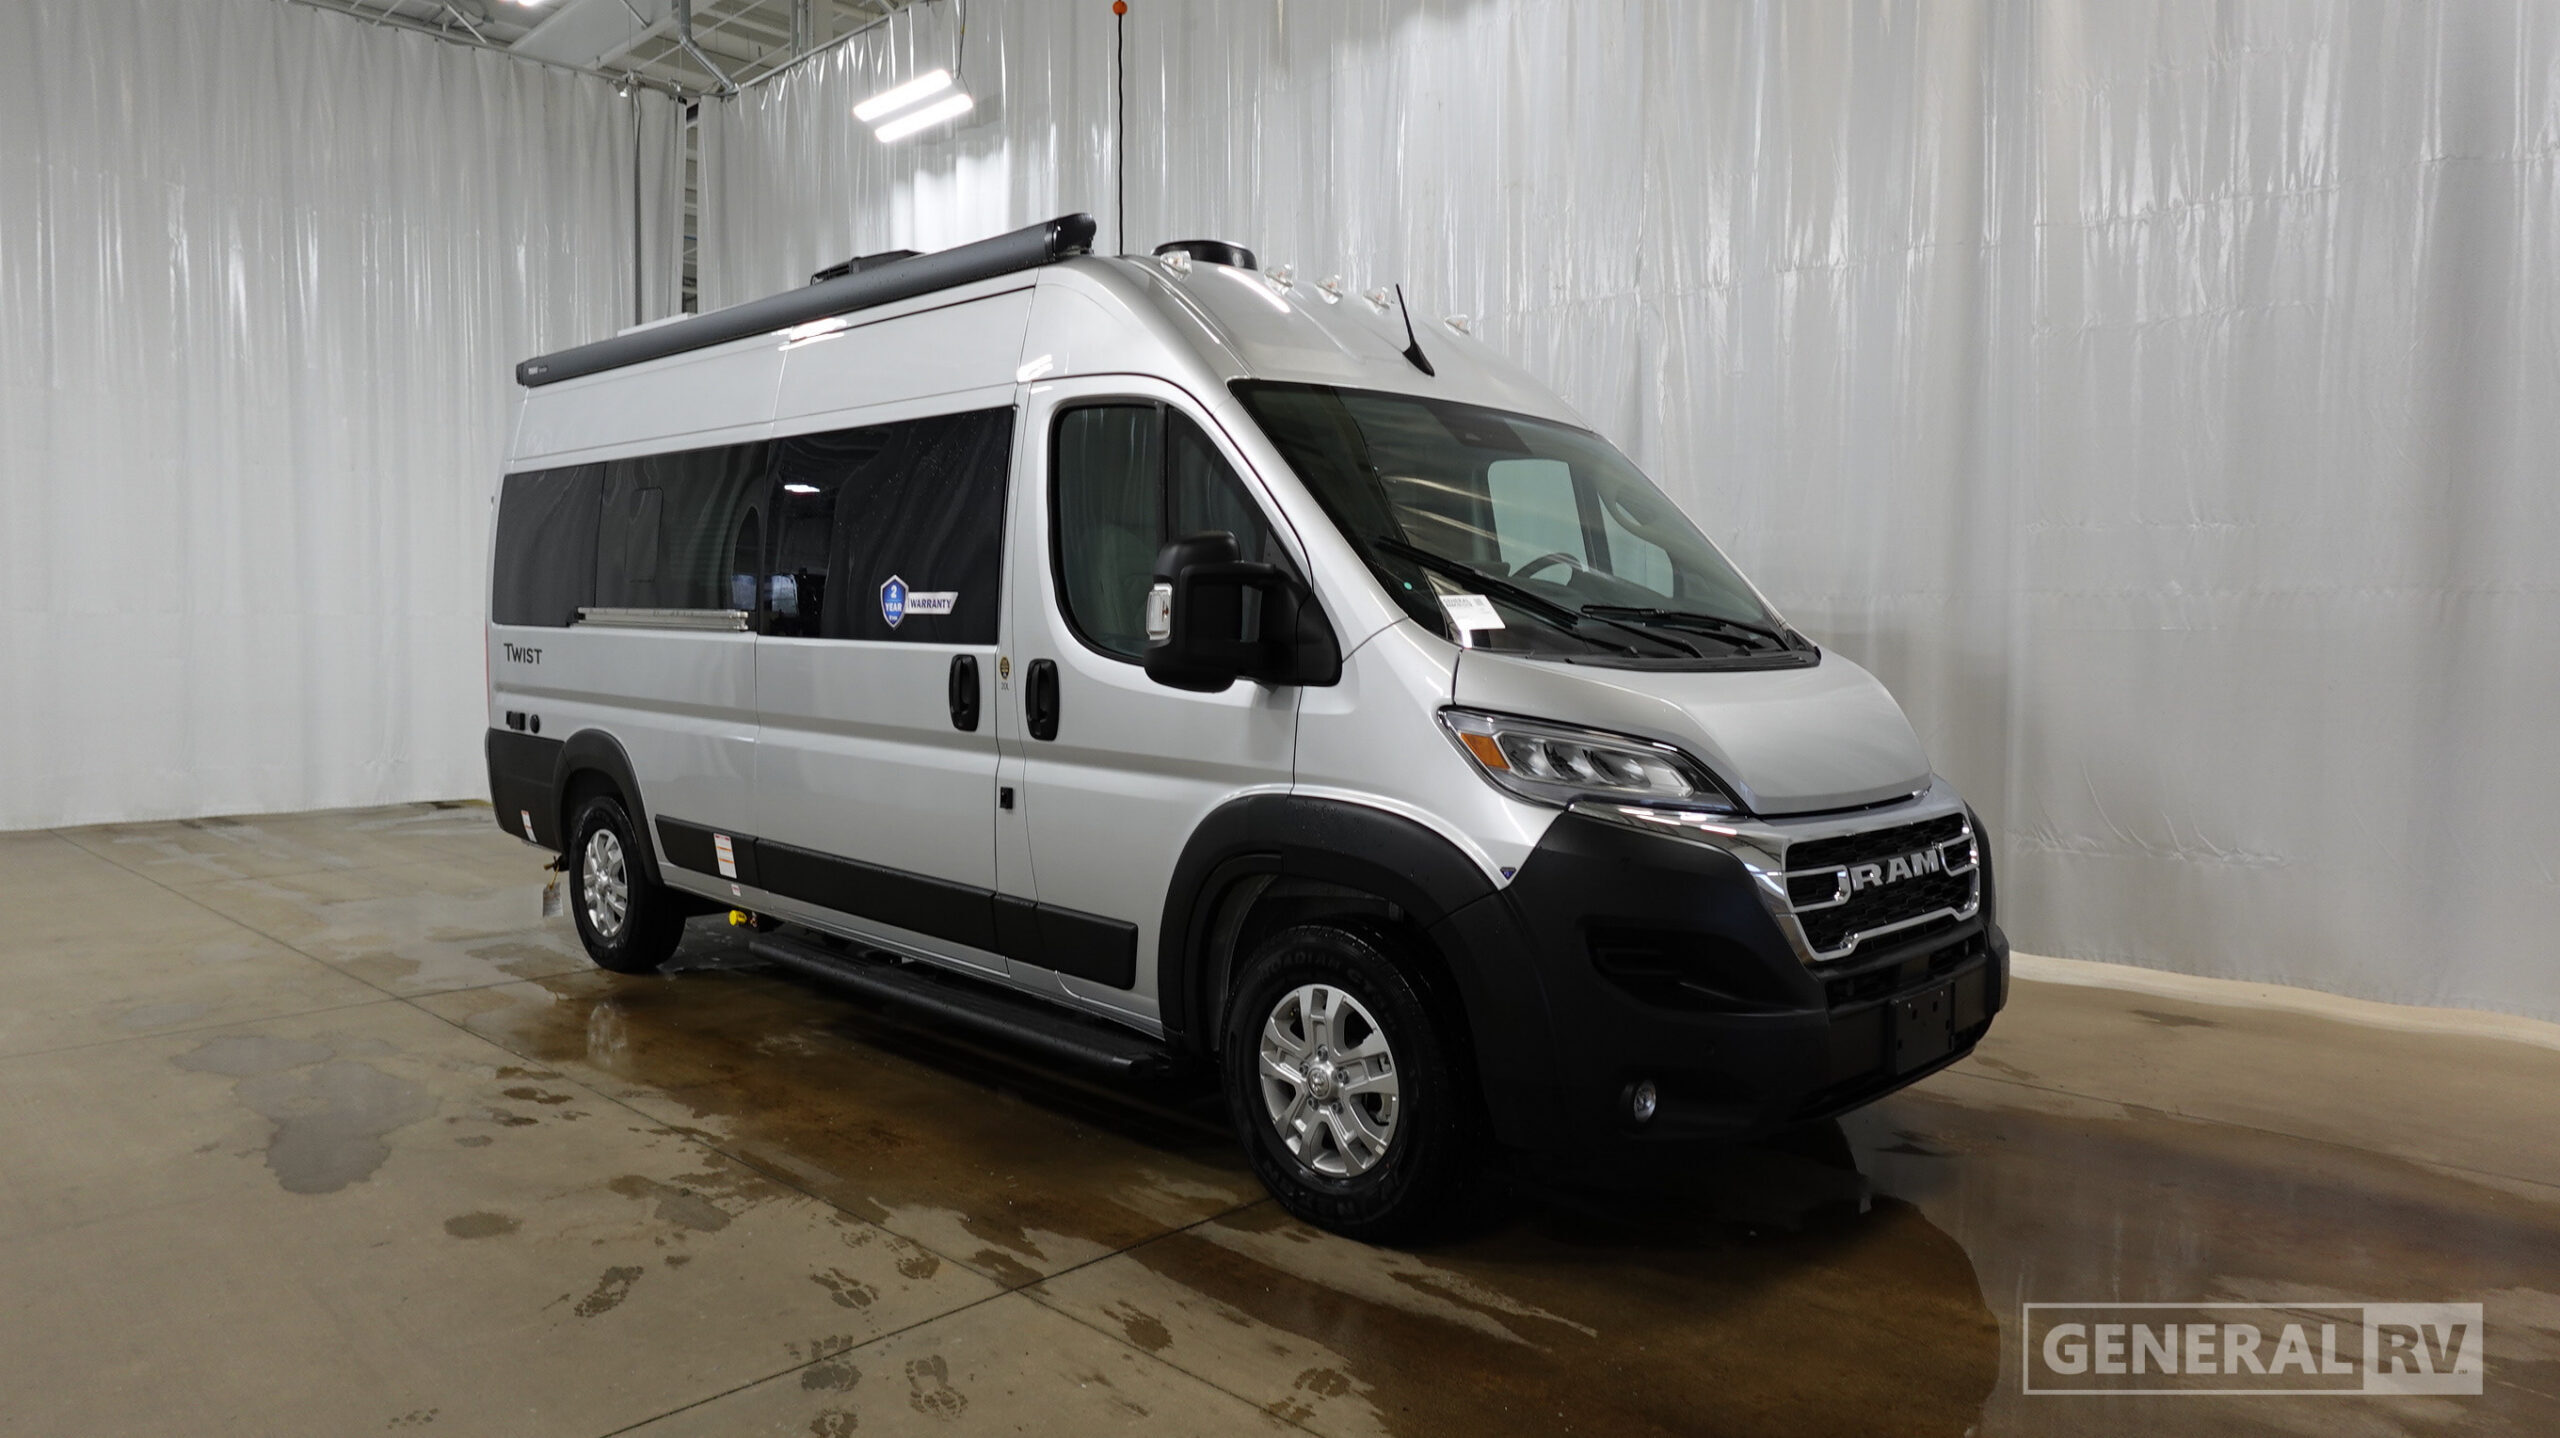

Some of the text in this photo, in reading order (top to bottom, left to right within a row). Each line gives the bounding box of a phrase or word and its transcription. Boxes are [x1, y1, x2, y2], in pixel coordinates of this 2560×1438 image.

[890, 584, 898, 599] 2
[885, 602, 902, 612] YEAR
[910, 598, 952, 608] WARRANTY
[503, 643, 543, 664] TWIST
[1850, 849, 1940, 891] RAM
